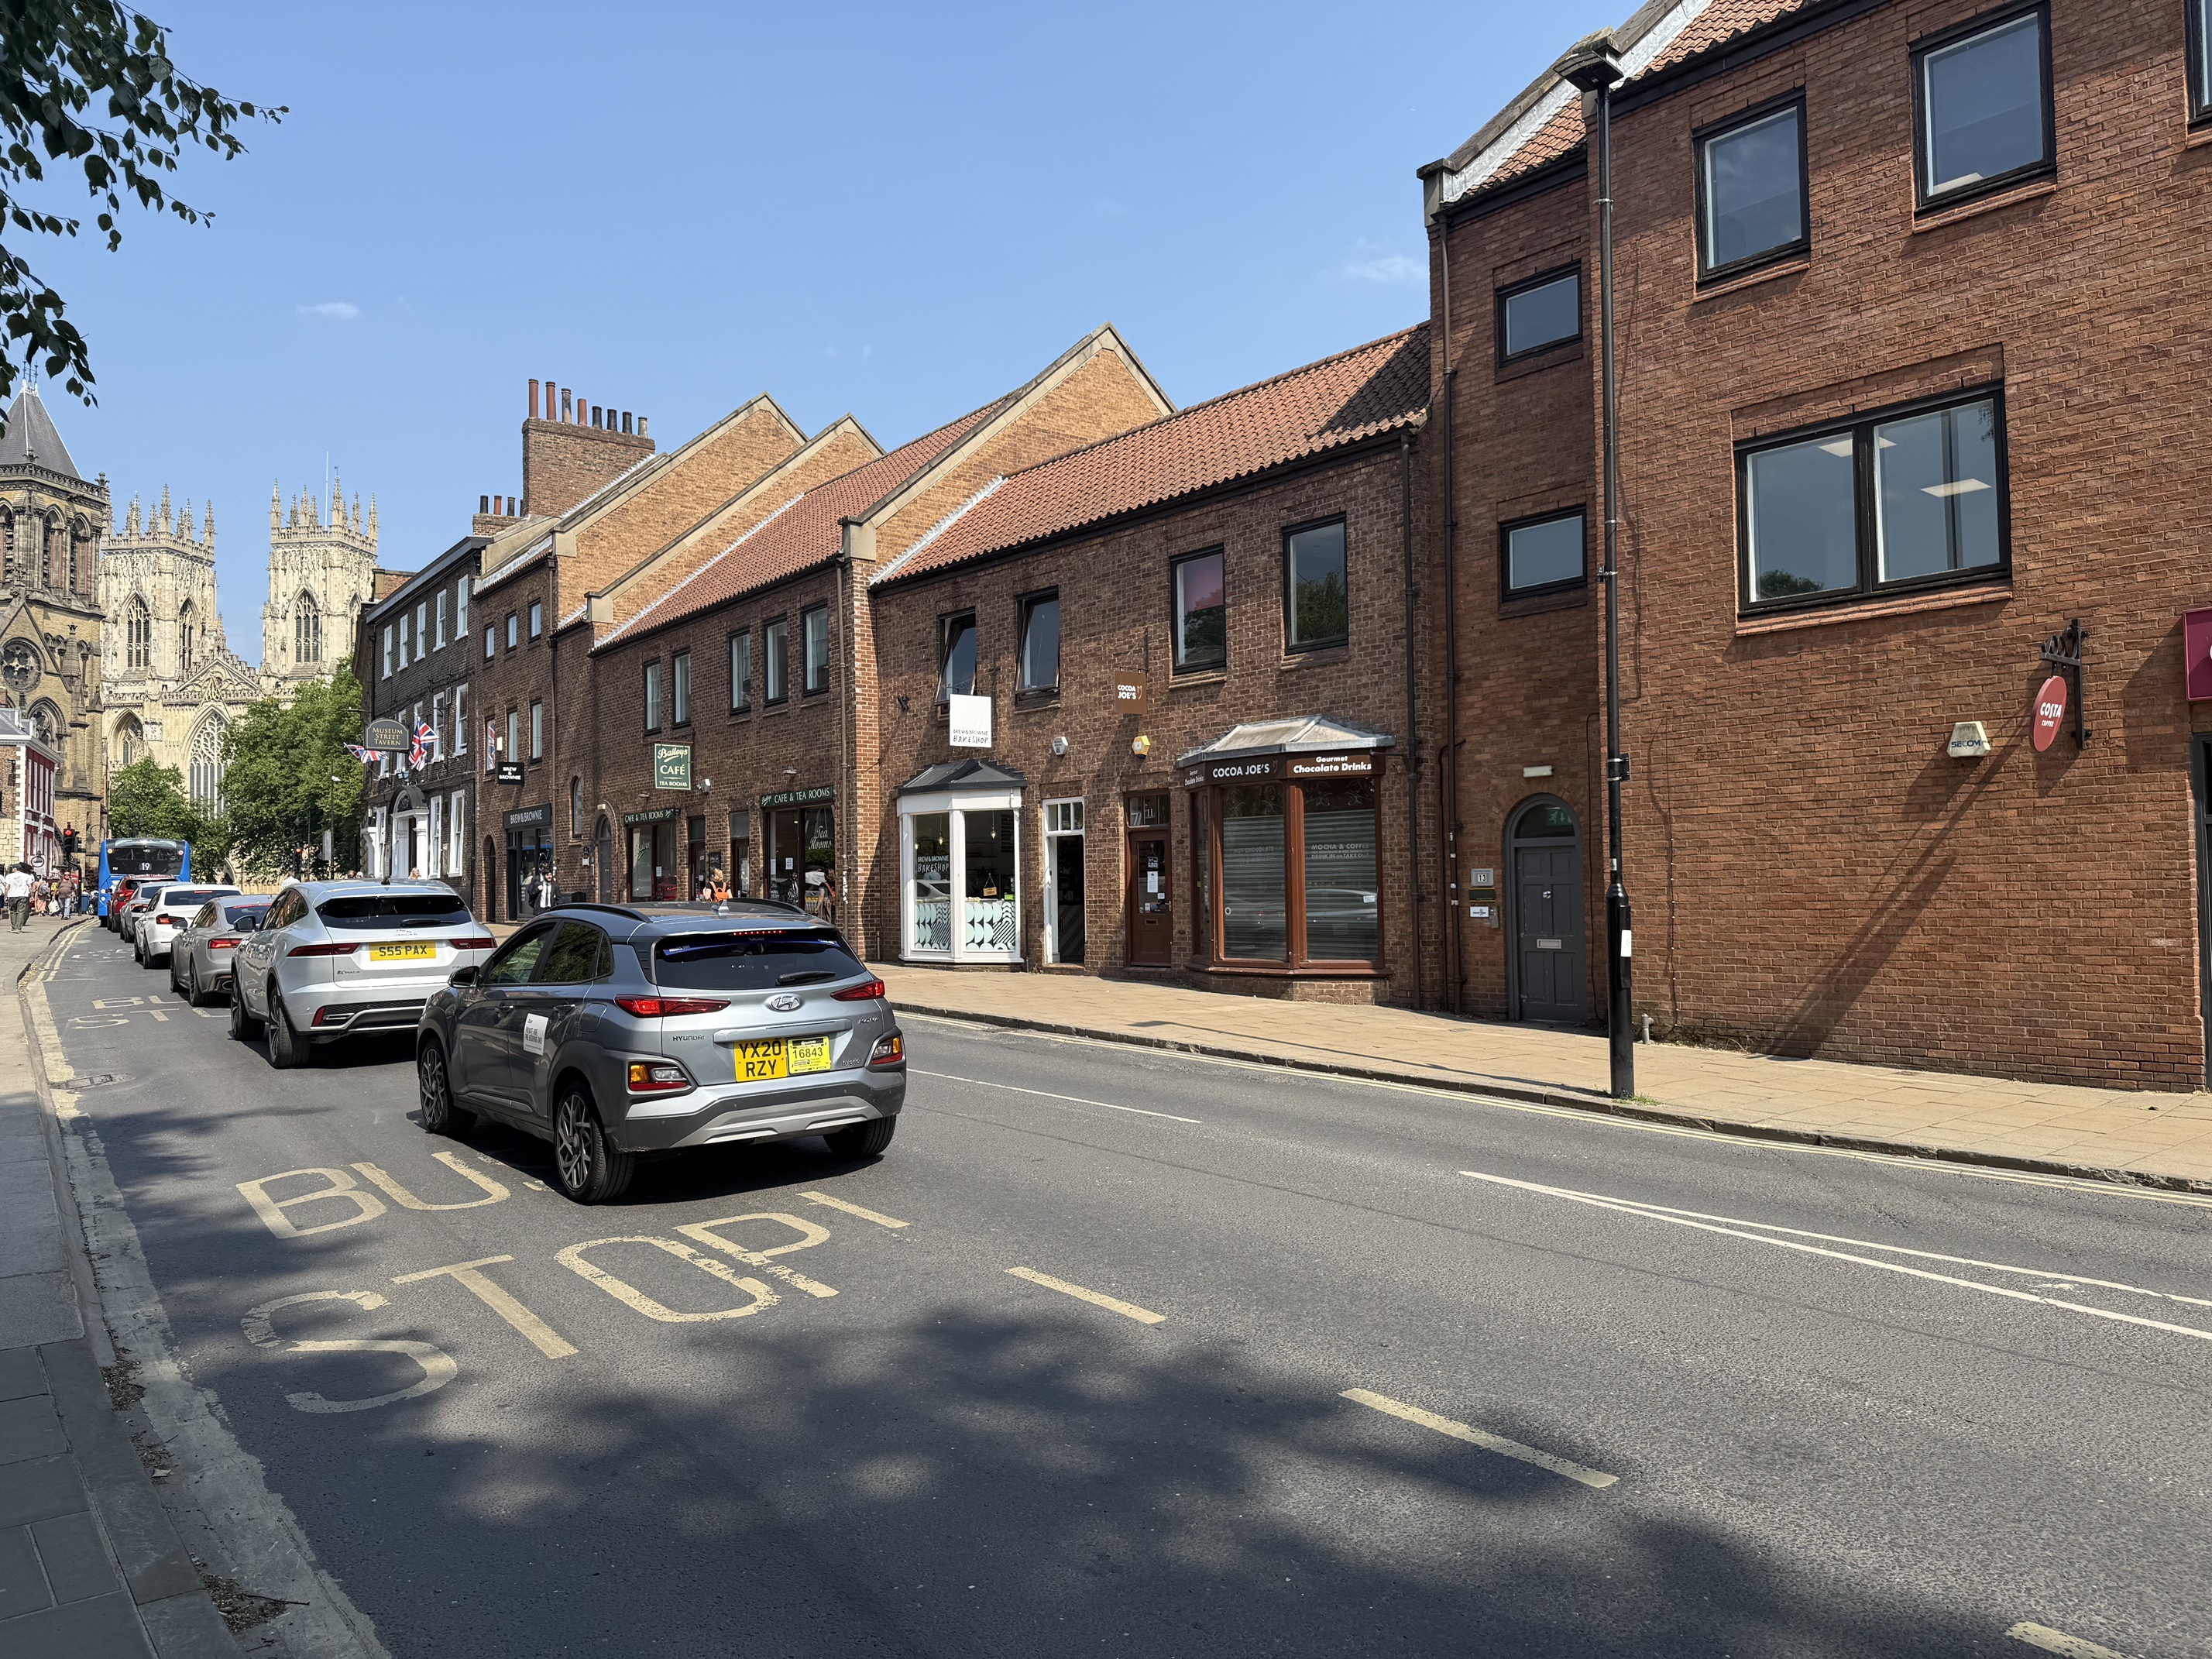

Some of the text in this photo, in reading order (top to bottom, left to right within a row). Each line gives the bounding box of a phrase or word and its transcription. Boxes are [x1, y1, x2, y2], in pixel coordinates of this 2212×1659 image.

[1118, 691, 1137, 700] JOE'S
[2039, 702, 2063, 719] COSTA
[953, 735, 988, 744] BAKESHOP
[1950, 739, 1981, 748] SECOM
[657, 747, 689, 760] Baileys
[1315, 755, 1348, 764] Gourmet
[659, 764, 685, 775] CAFÉ
[1212, 763, 1270, 778] COCOA JOE'S
[1293, 762, 1372, 774] Chocolate Drinks
[774, 793, 787, 804] CAFE
[789, 792, 794, 802] &
[795, 791, 807, 801] TEA
[809, 787, 830, 799] ROOMS
[624, 814, 634, 823] CAFE
[648, 810, 664, 819] ROOMS
[816, 825, 828, 839] Tea
[809, 836, 832, 850] Rooms
[141, 862, 150, 871] 19
[917, 862, 950, 873] BAKESHOP
[1479, 874, 1486, 882] 13
[379, 944, 428, 957] S55 PAX
[739, 1040, 781, 1059] YX20
[792, 1046, 823, 1060] 16843
[745, 1060, 777, 1077] RZY
[236, 1151, 542, 1239] BU
[240, 1213, 839, 1413] STOP
